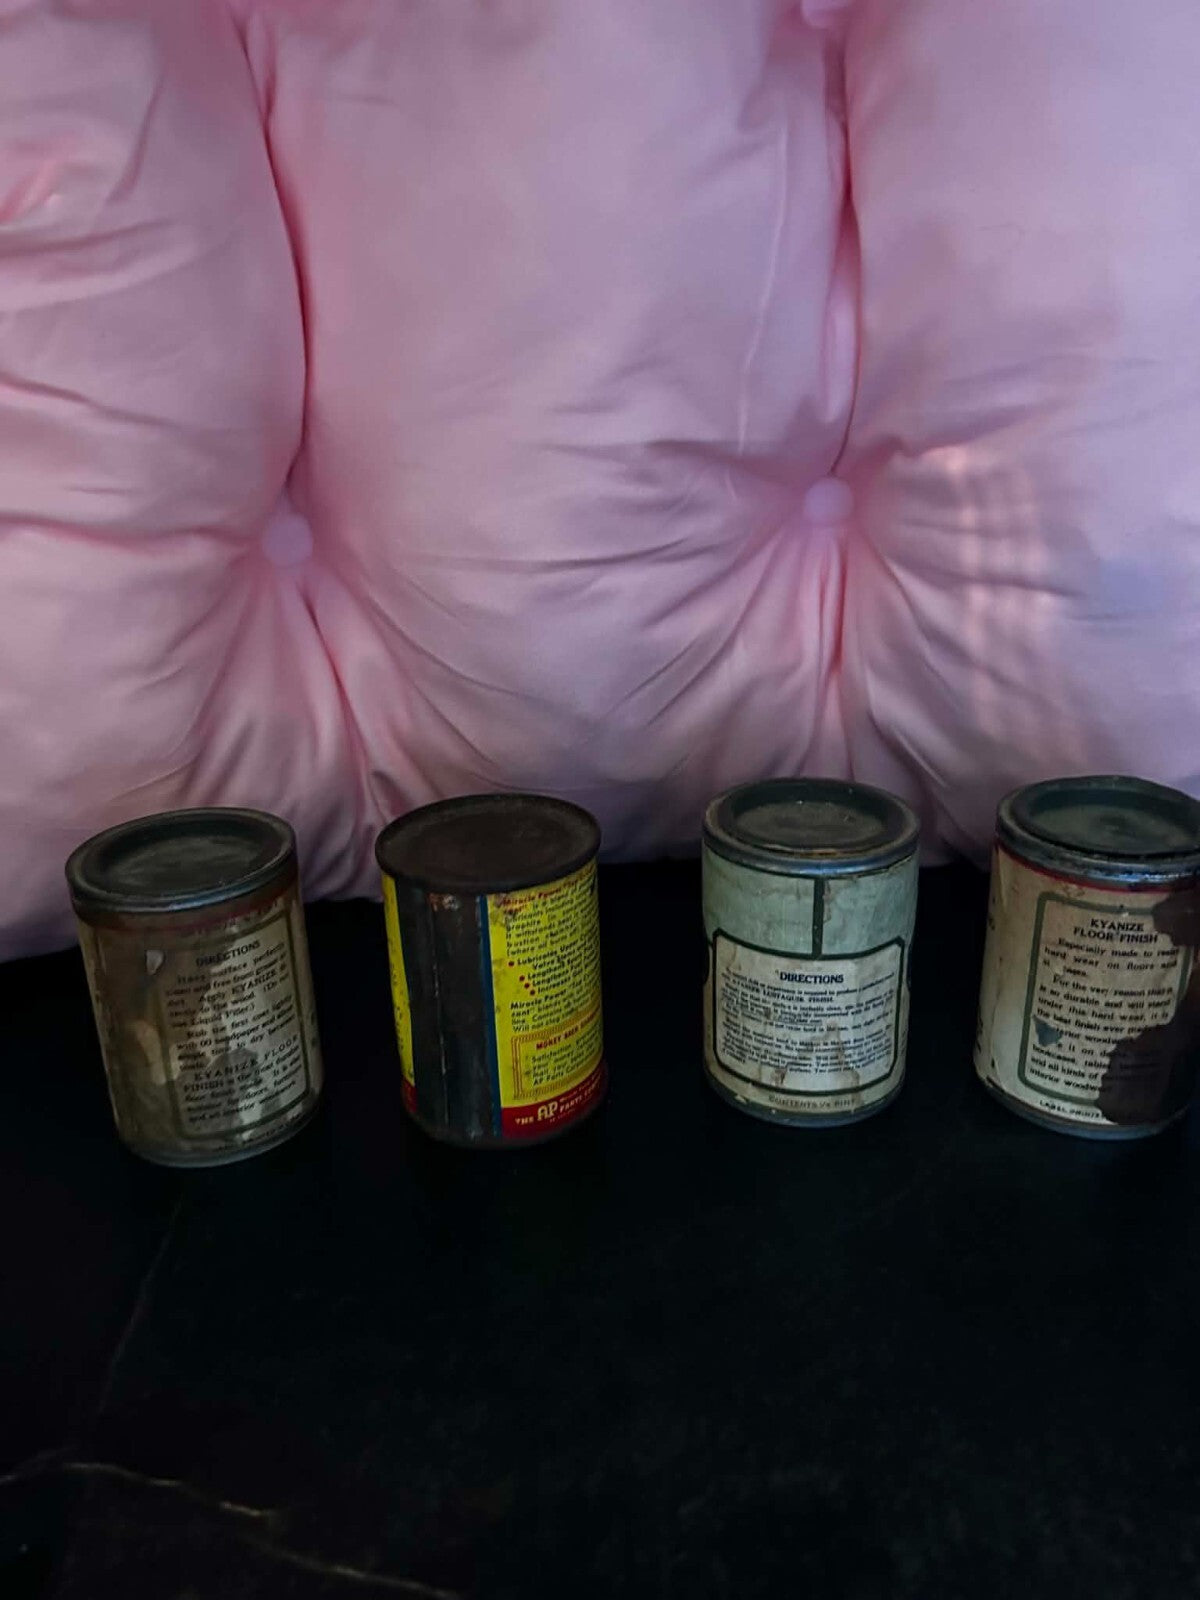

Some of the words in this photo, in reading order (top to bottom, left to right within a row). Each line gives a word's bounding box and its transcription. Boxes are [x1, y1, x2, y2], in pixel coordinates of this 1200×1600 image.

[1090, 918, 1145, 932] KYANIZE
[1073, 927, 1114, 942] FLOOR
[1119, 933, 1159, 944] FINISH
[195, 940, 260, 967] DIRECTIONS
[1058, 937, 1106, 957] Especially
[1111, 950, 1139, 958] made
[1143, 950, 1154, 958] to
[1044, 946, 1067, 960] hard
[1073, 955, 1100, 968] wear
[1106, 961, 1121, 970] on
[1126, 959, 1155, 970] floors
[199, 991, 226, 1004] Apply
[231, 968, 276, 995] KYANIZE
[213, 979, 232, 989] free
[780, 972, 845, 985] DIRECTIONS
[1053, 974, 1070, 987] For
[1072, 979, 1088, 990] the
[1090, 986, 1109, 998] very
[1113, 988, 1145, 997] reason
[510, 999, 543, 1010] Miracle
[543, 988, 568, 1003] Power
[1063, 991, 1101, 1006] durable
[1104, 1000, 1124, 1009] and
[1127, 999, 1145, 1009] will
[1147, 998, 1171, 1009] stand
[1038, 997, 1063, 1010] under
[1068, 1006, 1086, 1016] this
[1091, 1010, 1115, 1021] hard
[186, 1029, 207, 1039] Rub
[212, 1026, 228, 1035] the
[231, 1017, 249, 1030] first
[190, 1012, 223, 1027] Liquid
[512, 1023, 530, 1034] Will
[1036, 1007, 1051, 1017] the
[1074, 1017, 1101, 1031] finish
[1103, 1024, 1125, 1033] ever
[177, 1039, 199, 1051] with
[249, 1032, 264, 1046] dry
[536, 1034, 562, 1051] MONEY
[1080, 1047, 1095, 1056] on
[194, 1057, 259, 1081] KYANIZE
[1030, 1056, 1047, 1069] and
[1047, 1061, 1060, 1072] all
[1060, 1065, 1086, 1079] kinds
[1088, 1071, 1099, 1082] of
[183, 1080, 225, 1094] FINISH
[769, 1093, 818, 1109] CONTENTS
[514, 1116, 535, 1126] THE
[536, 1100, 560, 1122] AP
